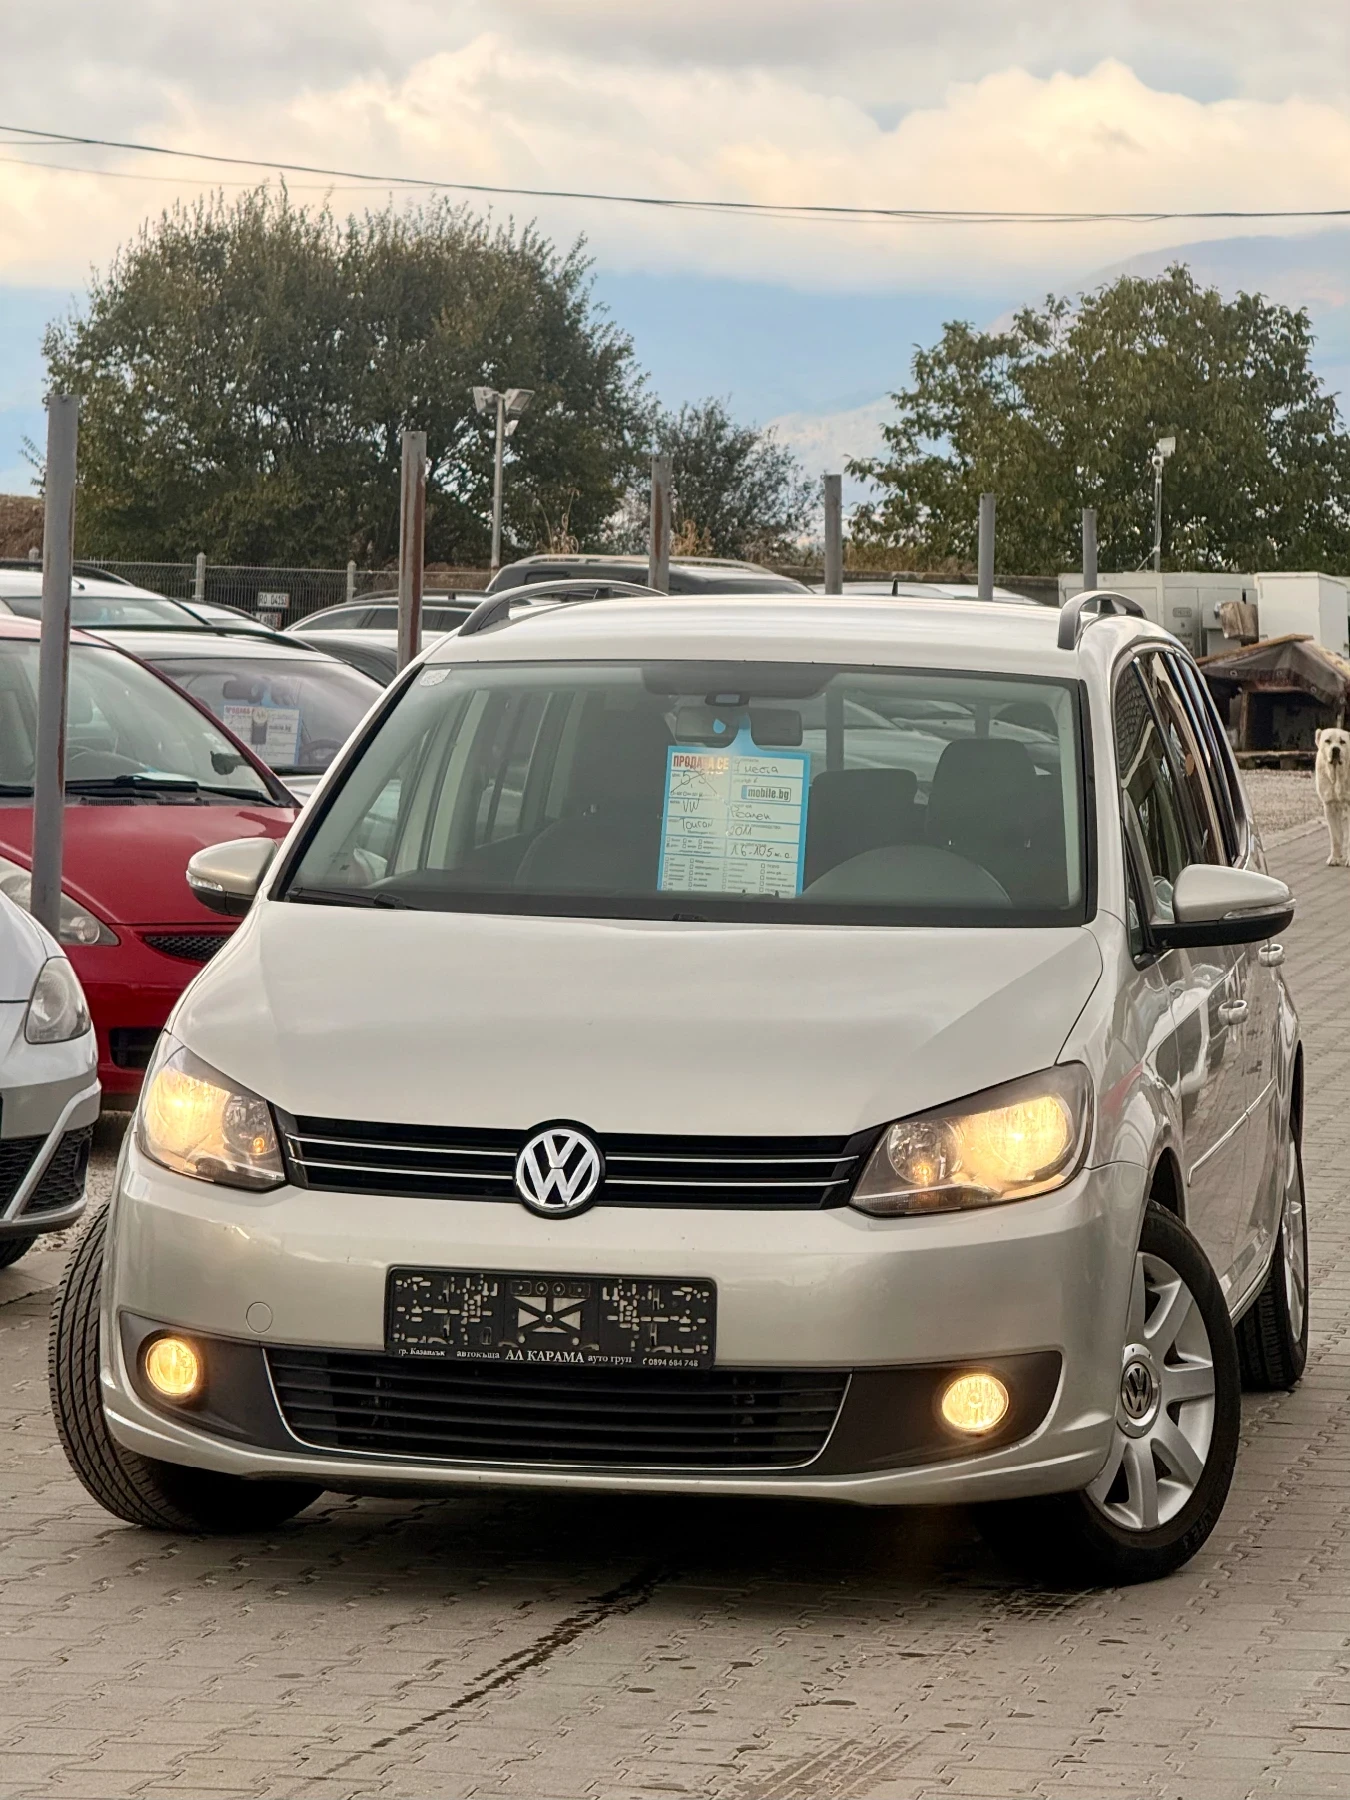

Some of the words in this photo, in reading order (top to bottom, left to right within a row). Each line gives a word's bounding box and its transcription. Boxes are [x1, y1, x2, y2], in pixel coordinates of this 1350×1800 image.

[747, 787, 790, 801] mobile.bg
[682, 798, 700, 813] VW
[728, 825, 752, 837] 2011
[517, 1128, 600, 1210] VW
[456, 1349, 501, 1359] автокъща
[505, 1349, 524, 1362] АЛ
[526, 1350, 585, 1364] КАРАМА
[587, 1354, 609, 1365] ауто
[610, 1355, 632, 1365] груп
[648, 1358, 667, 1366] 0894
[668, 1359, 683, 1367] 684
[684, 1359, 699, 1367] 748
